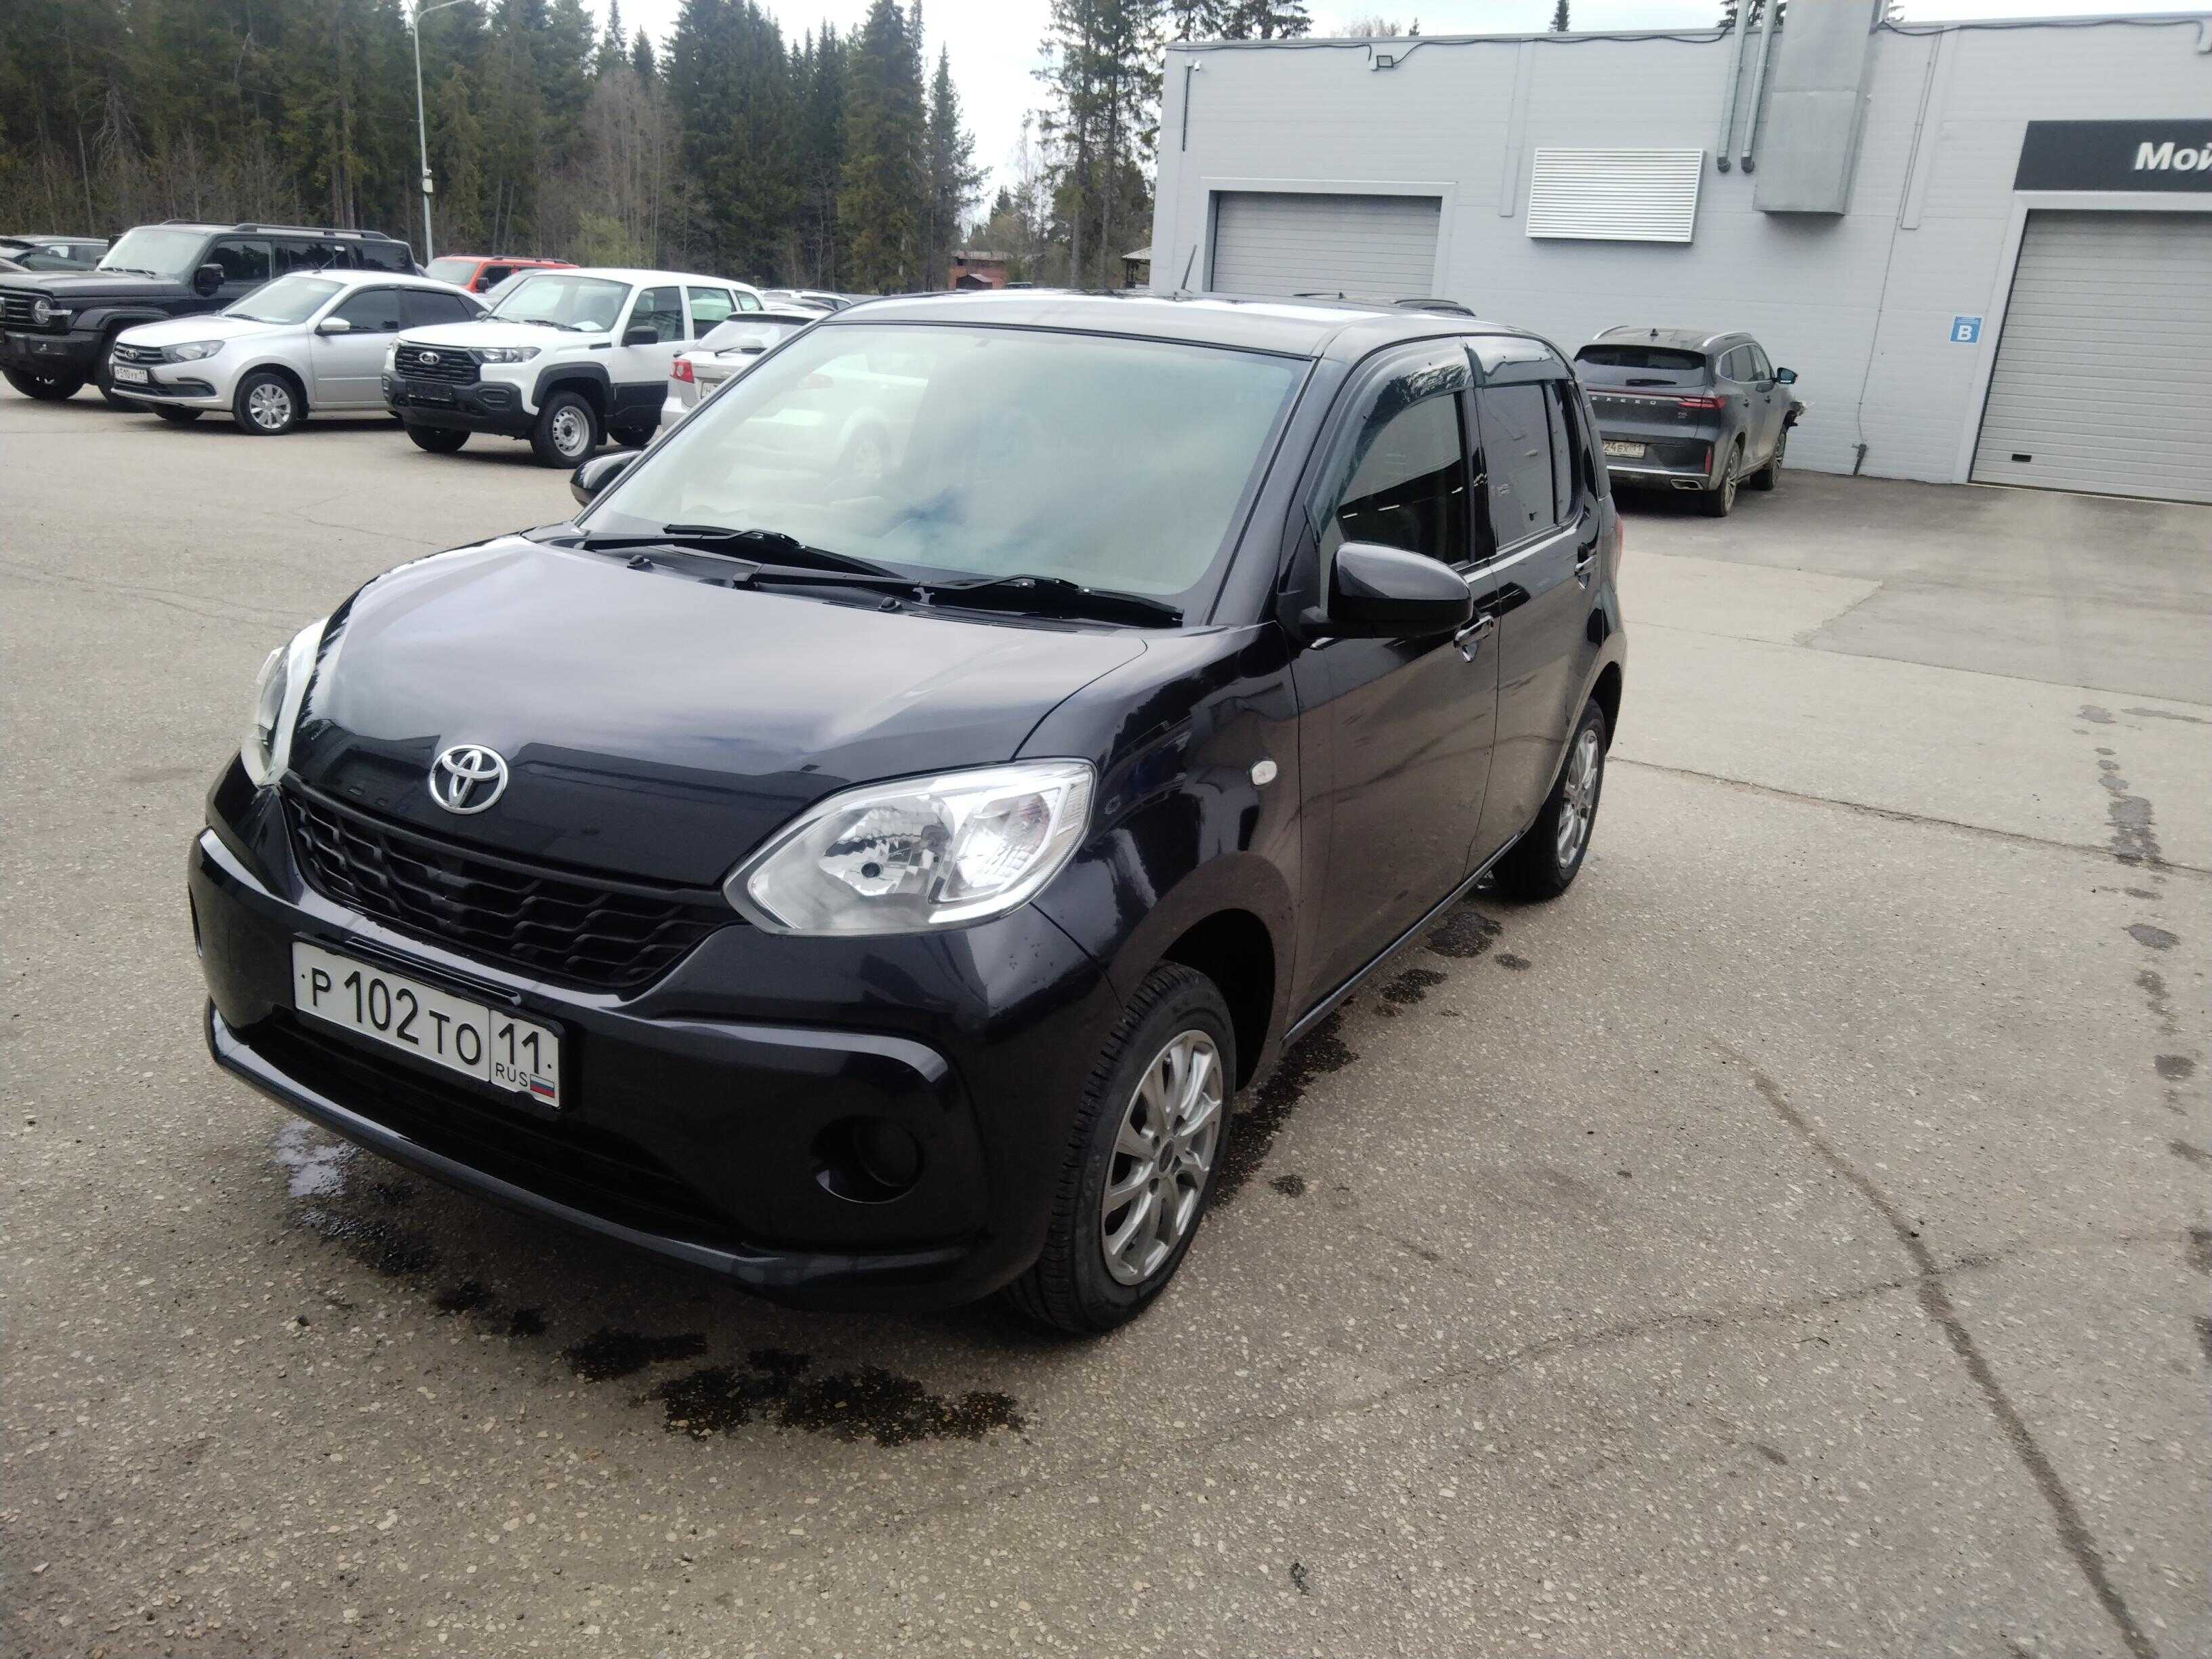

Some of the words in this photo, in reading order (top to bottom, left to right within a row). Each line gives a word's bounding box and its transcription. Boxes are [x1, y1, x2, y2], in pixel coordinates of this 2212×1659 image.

[1592, 396, 1656, 405] EXEED
[498, 1023, 539, 1074] 11
[495, 1062, 529, 1088] RUS
